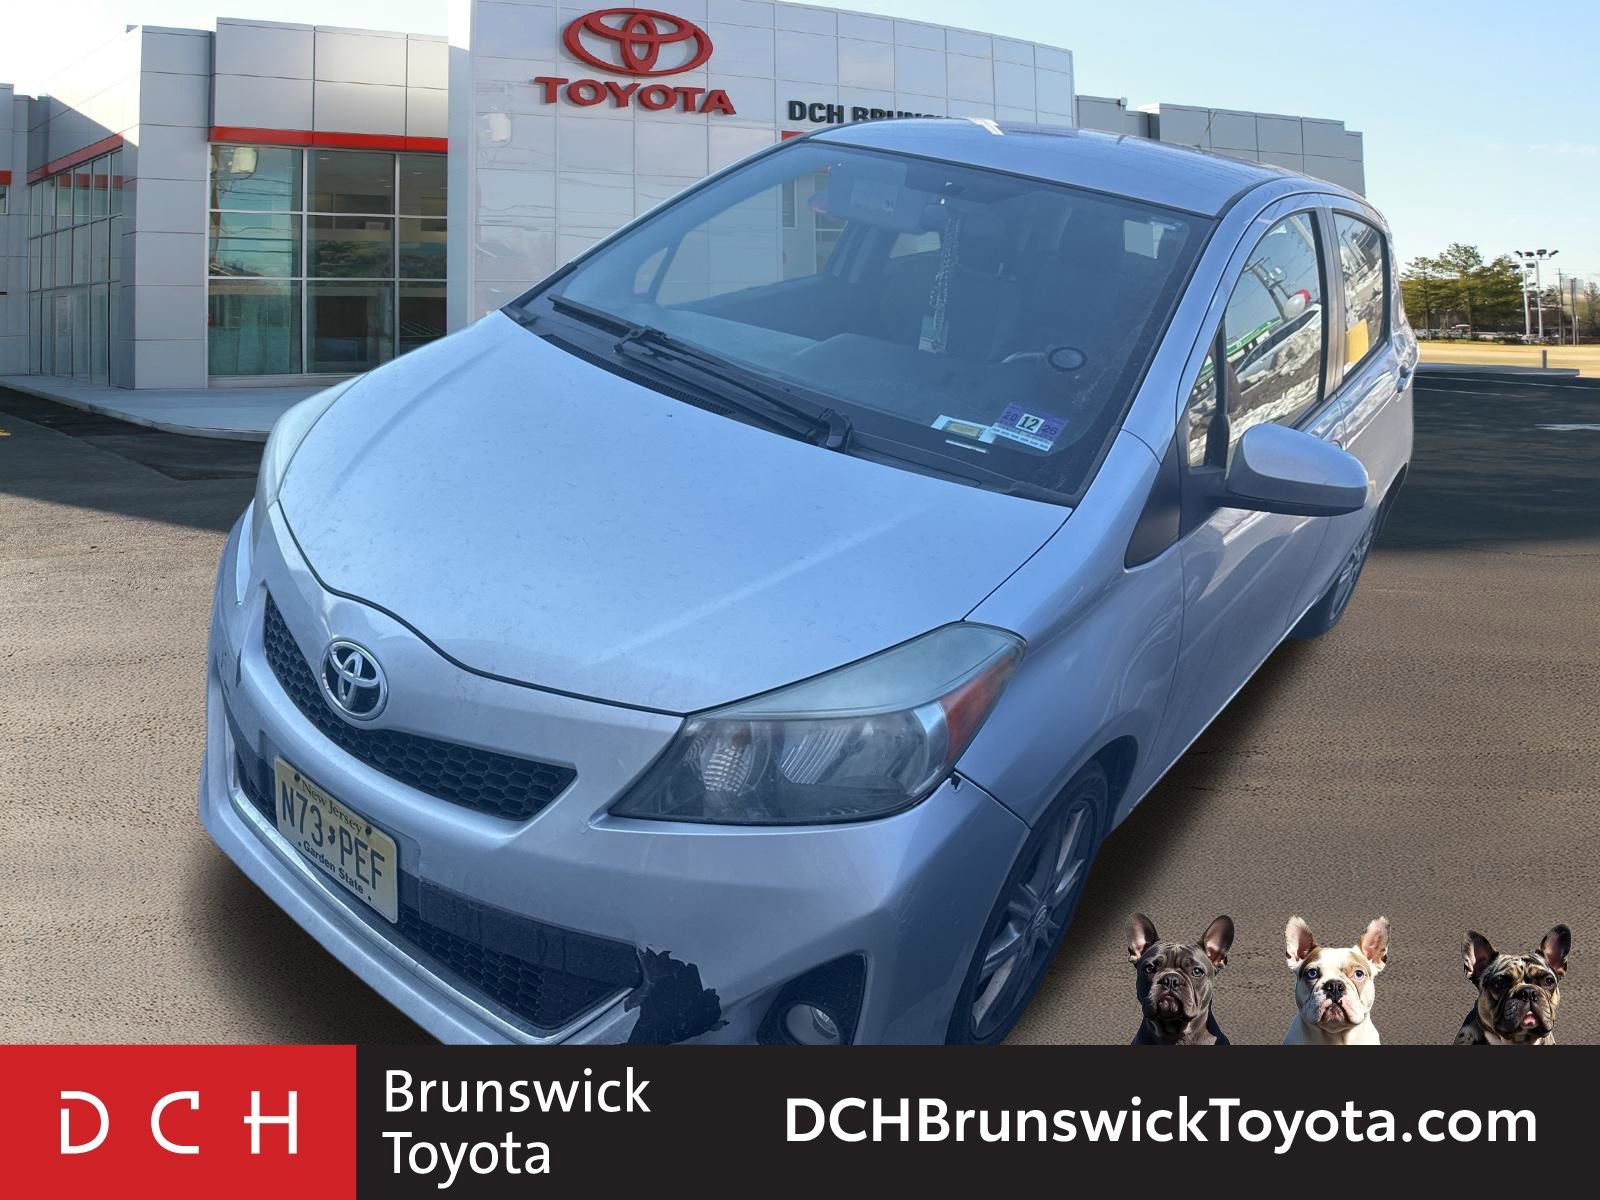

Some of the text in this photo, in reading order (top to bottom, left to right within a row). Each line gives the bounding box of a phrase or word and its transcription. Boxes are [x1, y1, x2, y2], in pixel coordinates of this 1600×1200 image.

[534, 76, 737, 116] TOYOTA
[788, 100, 845, 124] DCH
[1018, 416, 1040, 431] 12
[302, 780, 362, 836] New Jersey
[303, 840, 364, 894] Garden State
